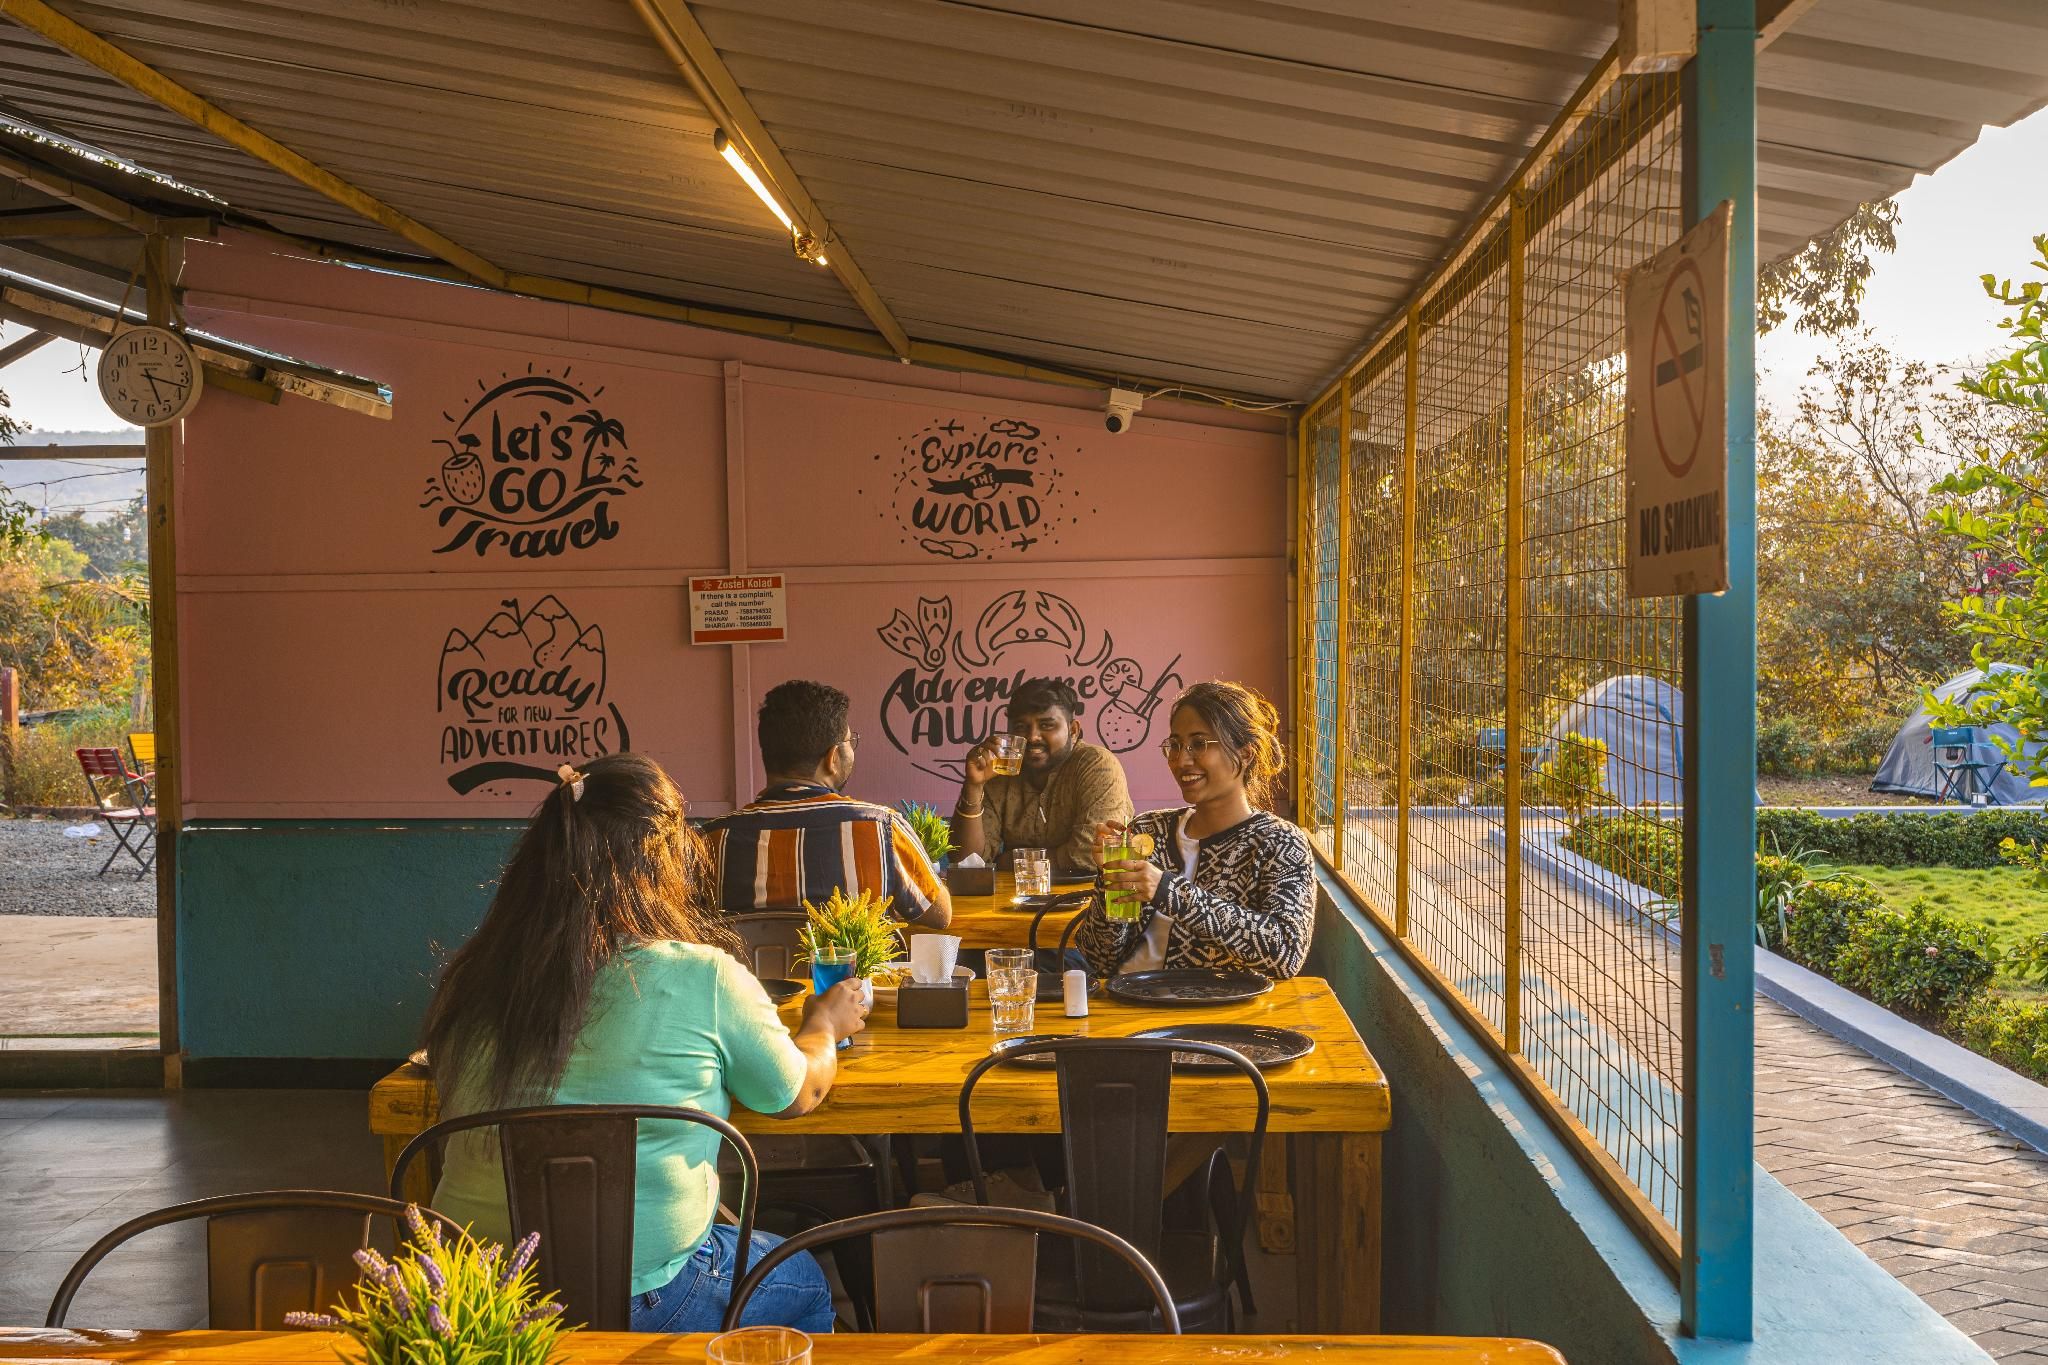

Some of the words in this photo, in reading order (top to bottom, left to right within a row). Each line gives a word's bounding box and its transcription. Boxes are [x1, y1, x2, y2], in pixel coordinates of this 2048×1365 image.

[129, 341, 138, 354] 11
[143, 336, 157, 350] 12
[164, 342, 168, 355] 1
[117, 354, 128, 368] 10
[175, 354, 183, 367] 2
[111, 369, 120, 382] 9
[180, 371, 189, 384] 3
[118, 388, 127, 401] 8
[175, 387, 182, 400] 4
[130, 400, 139, 412] 7
[146, 404, 156, 417] 6
[163, 400, 171, 412] 5
[492, 410, 573, 463] Let's
[920, 433, 1039, 473] Explore
[969, 472, 994, 488] THE
[489, 467, 566, 514] GO
[912, 496, 1041, 535] WORLD
[432, 502, 619, 558] Travel
[1640, 506, 1660, 557] NO
[1664, 490, 1719, 554] SMOKING
[717, 580, 744, 590] Zostel
[747, 578, 772, 588] Kolad
[707, 592, 724, 600] there
[739, 591, 774, 599] complaint,
[739, 599, 764, 607] number
[447, 665, 595, 717] Ready
[498, 707, 518, 723] FOR
[524, 706, 552, 721] NEW
[440, 717, 608, 764] ADVENTURES
